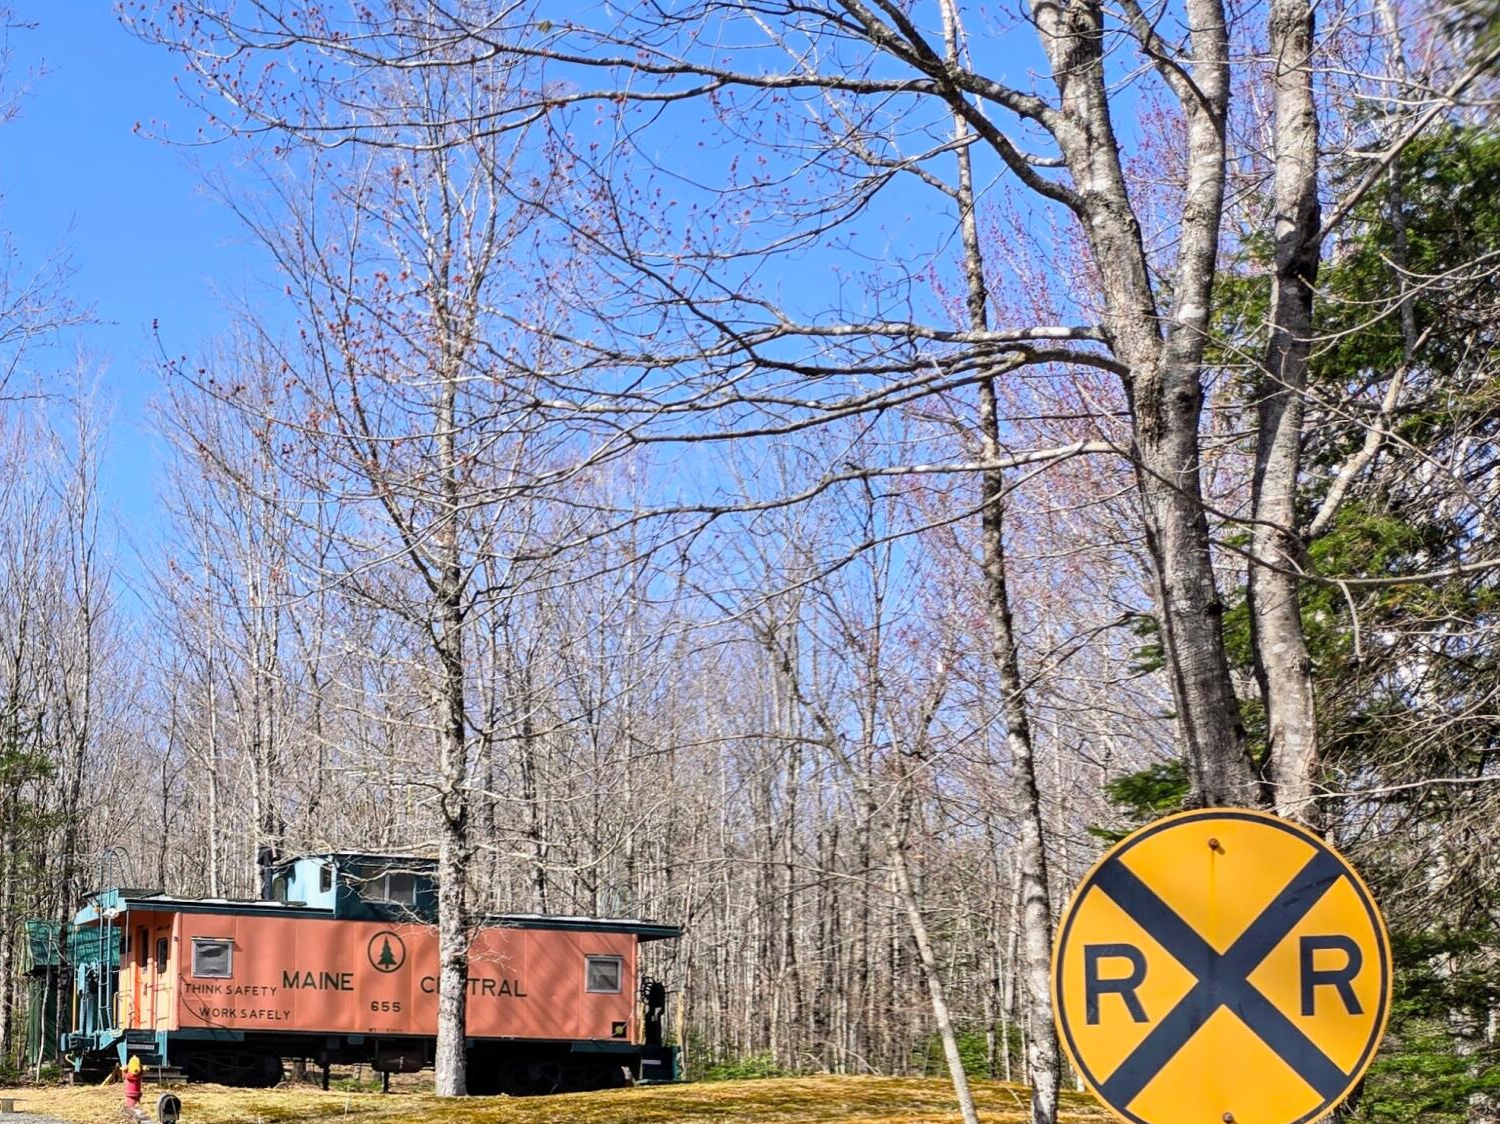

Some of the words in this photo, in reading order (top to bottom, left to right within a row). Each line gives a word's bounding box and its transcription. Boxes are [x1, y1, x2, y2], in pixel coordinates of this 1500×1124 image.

[282, 970, 355, 991] MAINE
[420, 975, 528, 998] CTRAL
[1083, 942, 1149, 1026] R
[1299, 934, 1364, 1017] R
[184, 983, 222, 995] THINK
[226, 985, 278, 997] SAFETY
[199, 1007, 237, 1019] WORK
[240, 1008, 291, 1020] SAFELY
[371, 1000, 401, 1013] 655
